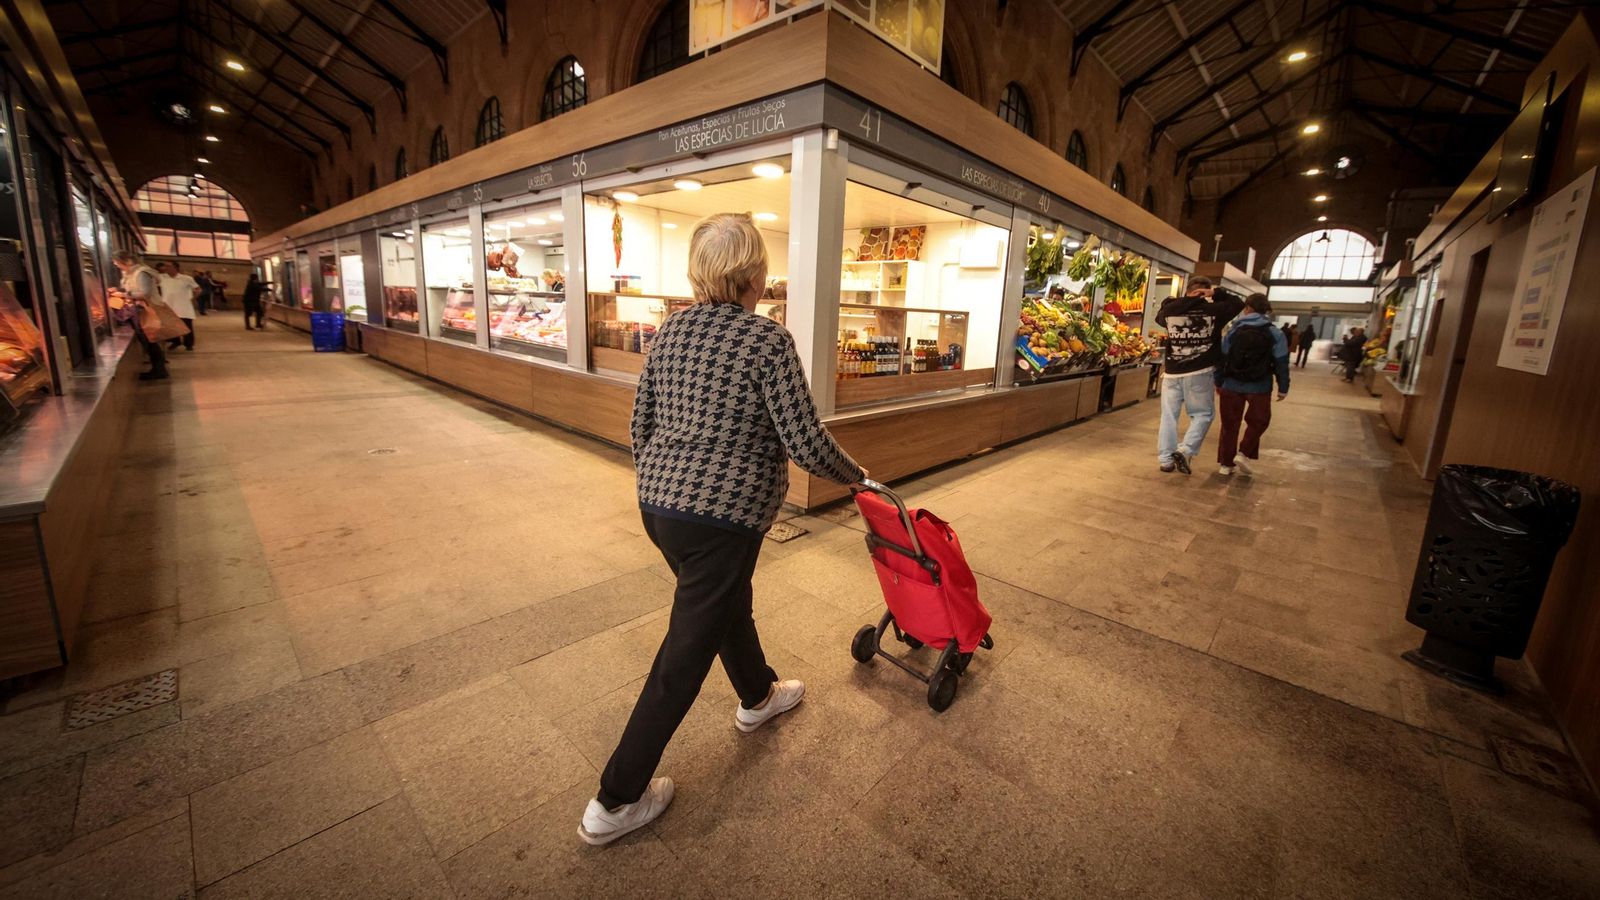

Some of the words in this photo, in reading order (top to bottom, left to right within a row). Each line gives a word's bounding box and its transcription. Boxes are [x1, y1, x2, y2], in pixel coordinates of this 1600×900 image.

[670, 124, 701, 138] Aceitunas,
[702, 114, 730, 130] Especias
[738, 107, 760, 119] Frutos
[762, 99, 786, 113] Secos
[675, 136, 690, 153] LAS
[691, 125, 733, 149] ESPECIAS
[735, 121, 749, 139] DE
[751, 110, 786, 135] LUCÍA
[859, 107, 881, 143] 41
[572, 152, 587, 177] 56
[527, 178, 534, 187] LA
[961, 164, 973, 181] LAS
[973, 170, 999, 192] ESPECIAS
[473, 183, 483, 202] 55
[1038, 193, 1050, 213] 40
